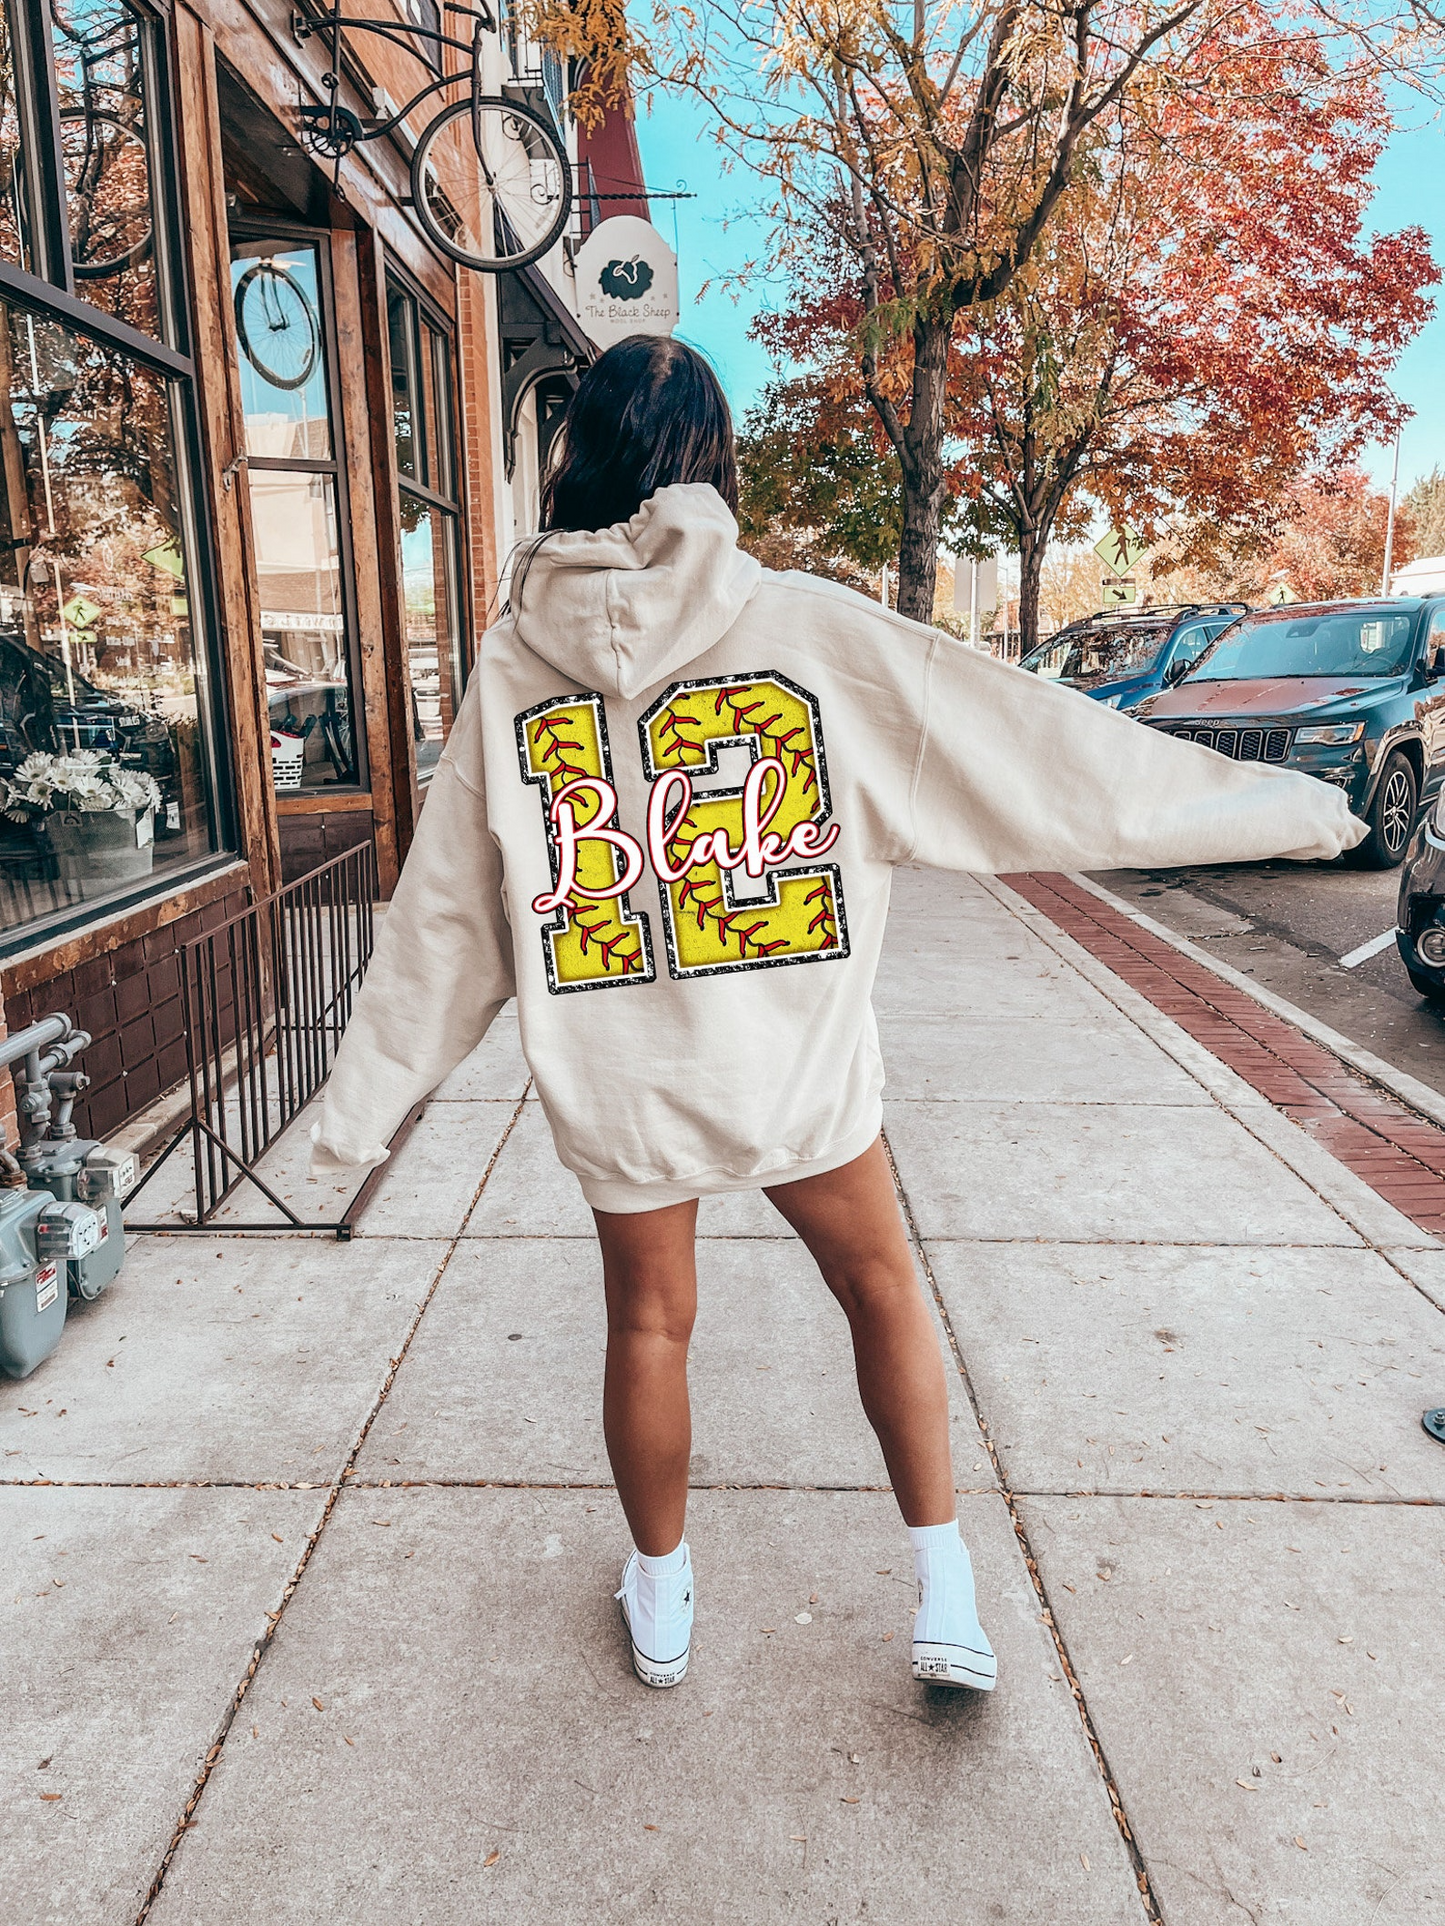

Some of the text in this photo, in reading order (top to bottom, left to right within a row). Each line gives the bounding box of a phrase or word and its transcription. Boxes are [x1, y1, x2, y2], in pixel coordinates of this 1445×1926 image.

[585, 303, 671, 319] The Black Sheep
[1194, 718, 1220, 727] Jeep
[513, 669, 852, 996] 12
[531, 755, 842, 915] Blake
